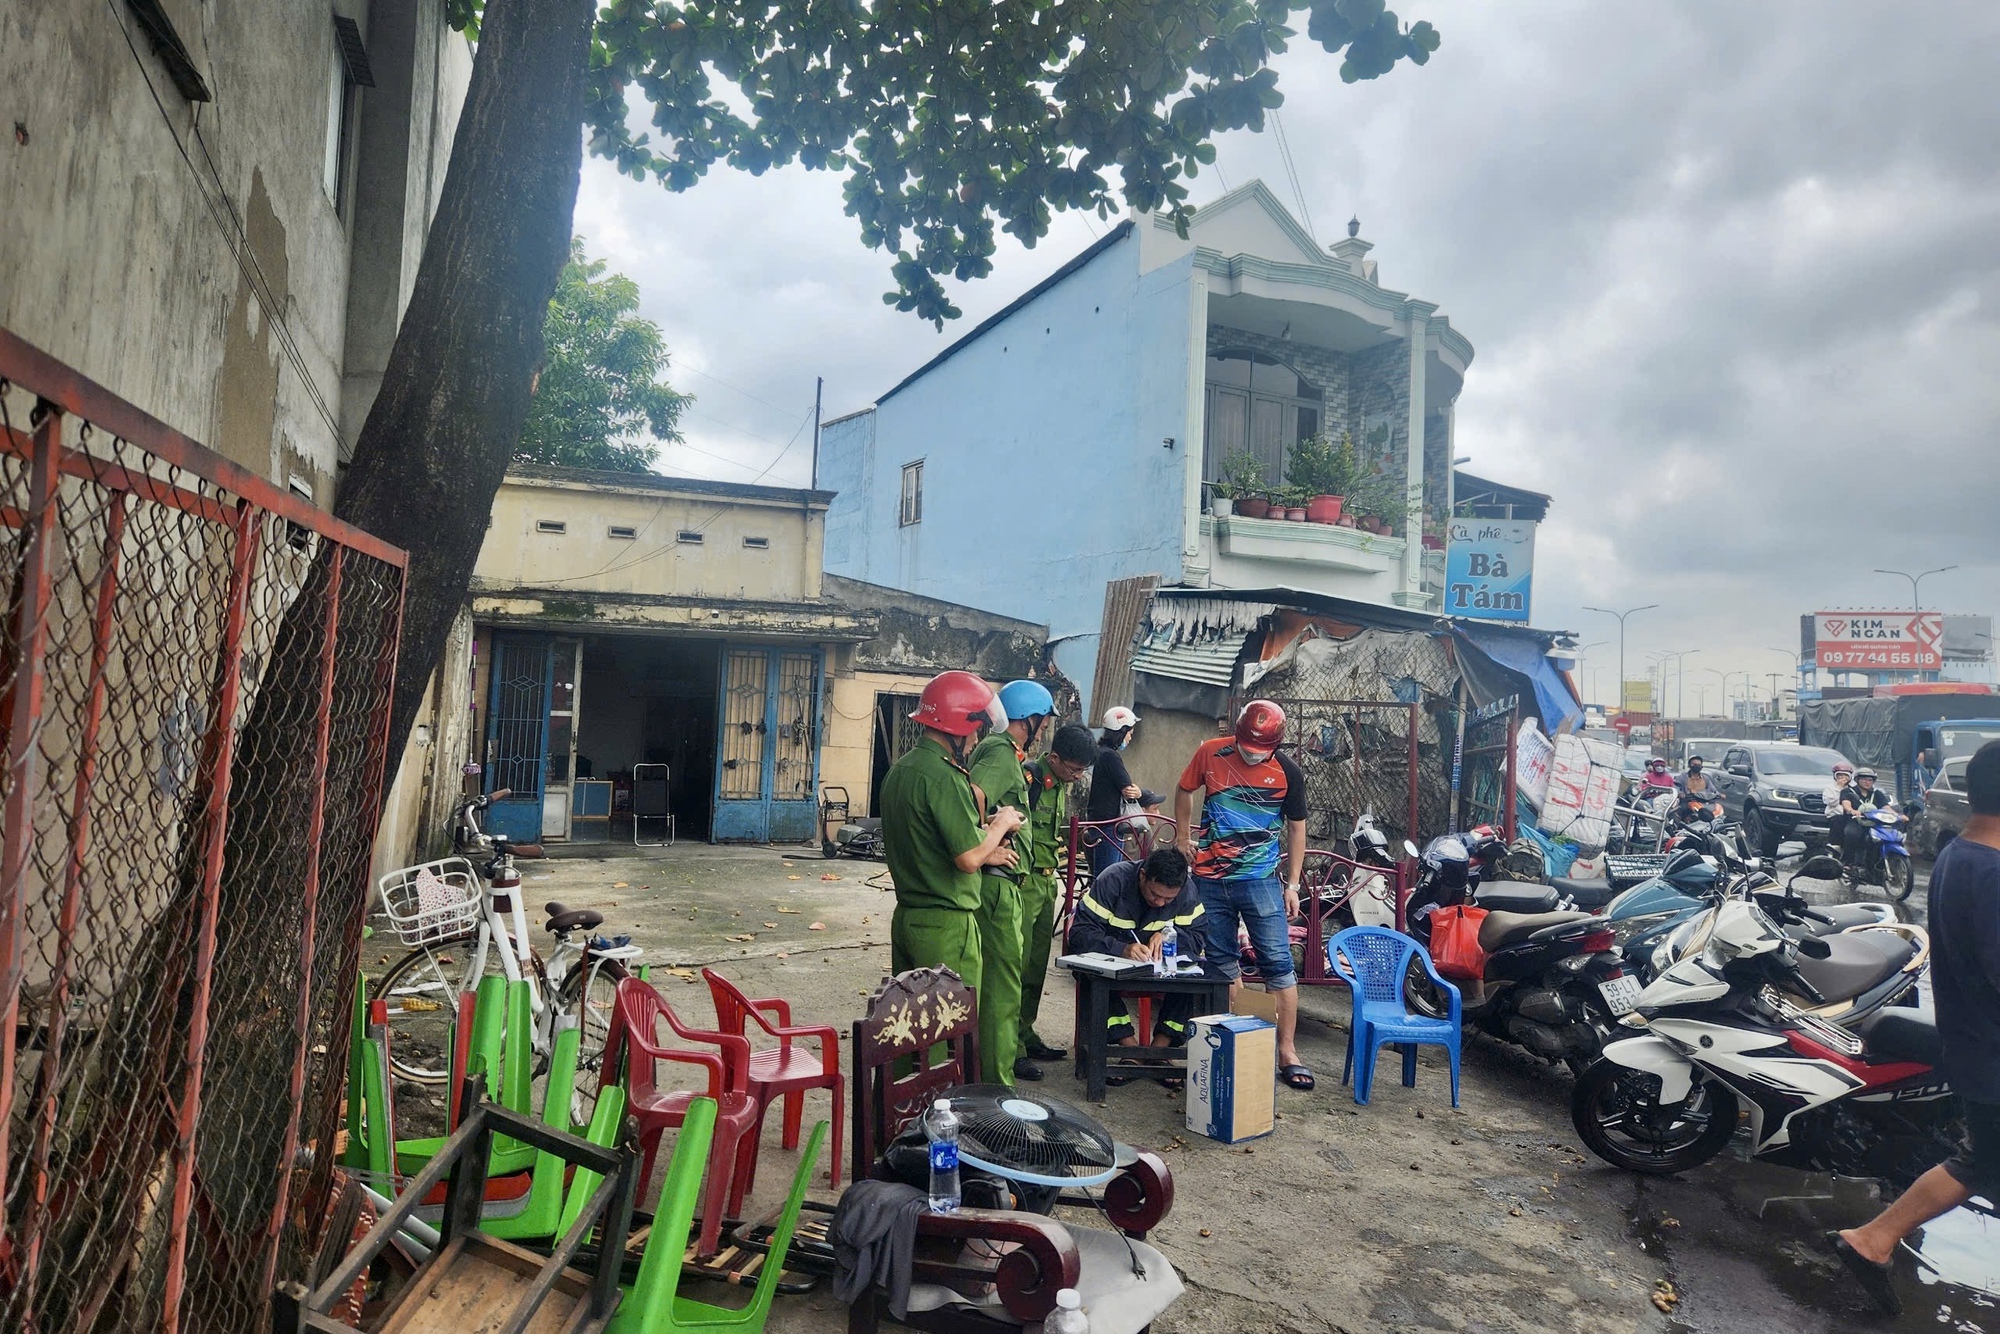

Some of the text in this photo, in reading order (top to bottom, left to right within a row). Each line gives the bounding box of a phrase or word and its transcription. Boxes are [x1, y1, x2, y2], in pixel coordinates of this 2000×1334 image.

[1451, 524, 1501, 542] Cà phê
[1468, 553, 1509, 578] Bà
[1451, 583, 1524, 611] Tám
[1851, 619, 1883, 629] KIM
[1851, 629, 1900, 639] NGAN
[1823, 652, 1843, 663] 09
[1846, 652, 1865, 663] 77
[1866, 652, 1888, 664] 44
[1890, 652, 1910, 664] 55
[1605, 979, 1636, 998] 59-L1
[1199, 1058, 1209, 1105] AQUAFINA
